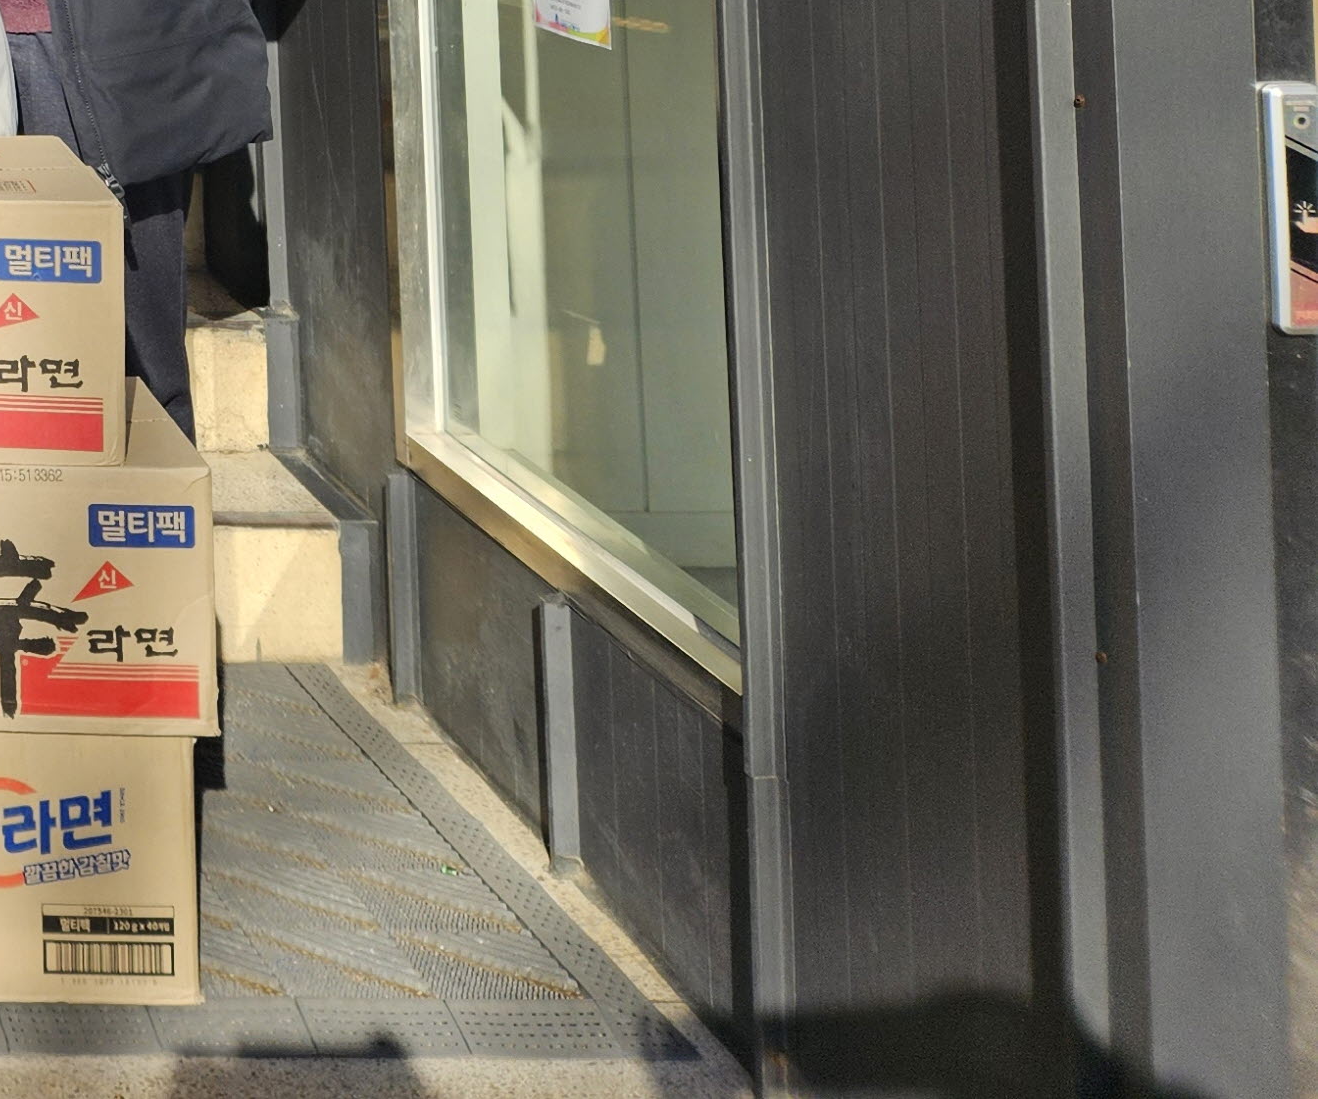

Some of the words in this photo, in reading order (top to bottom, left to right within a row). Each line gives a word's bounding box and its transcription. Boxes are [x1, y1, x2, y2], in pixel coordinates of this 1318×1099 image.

[5, 245, 93, 277] 멀티팩
[3, 301, 23, 321] 신
[97, 510, 186, 543] 멀티팩
[97, 570, 116, 589] 신
[87, 624, 178, 662] 라면
[23, 858, 75, 886] 깔끔한
[75, 849, 131, 878] 감칠맛
